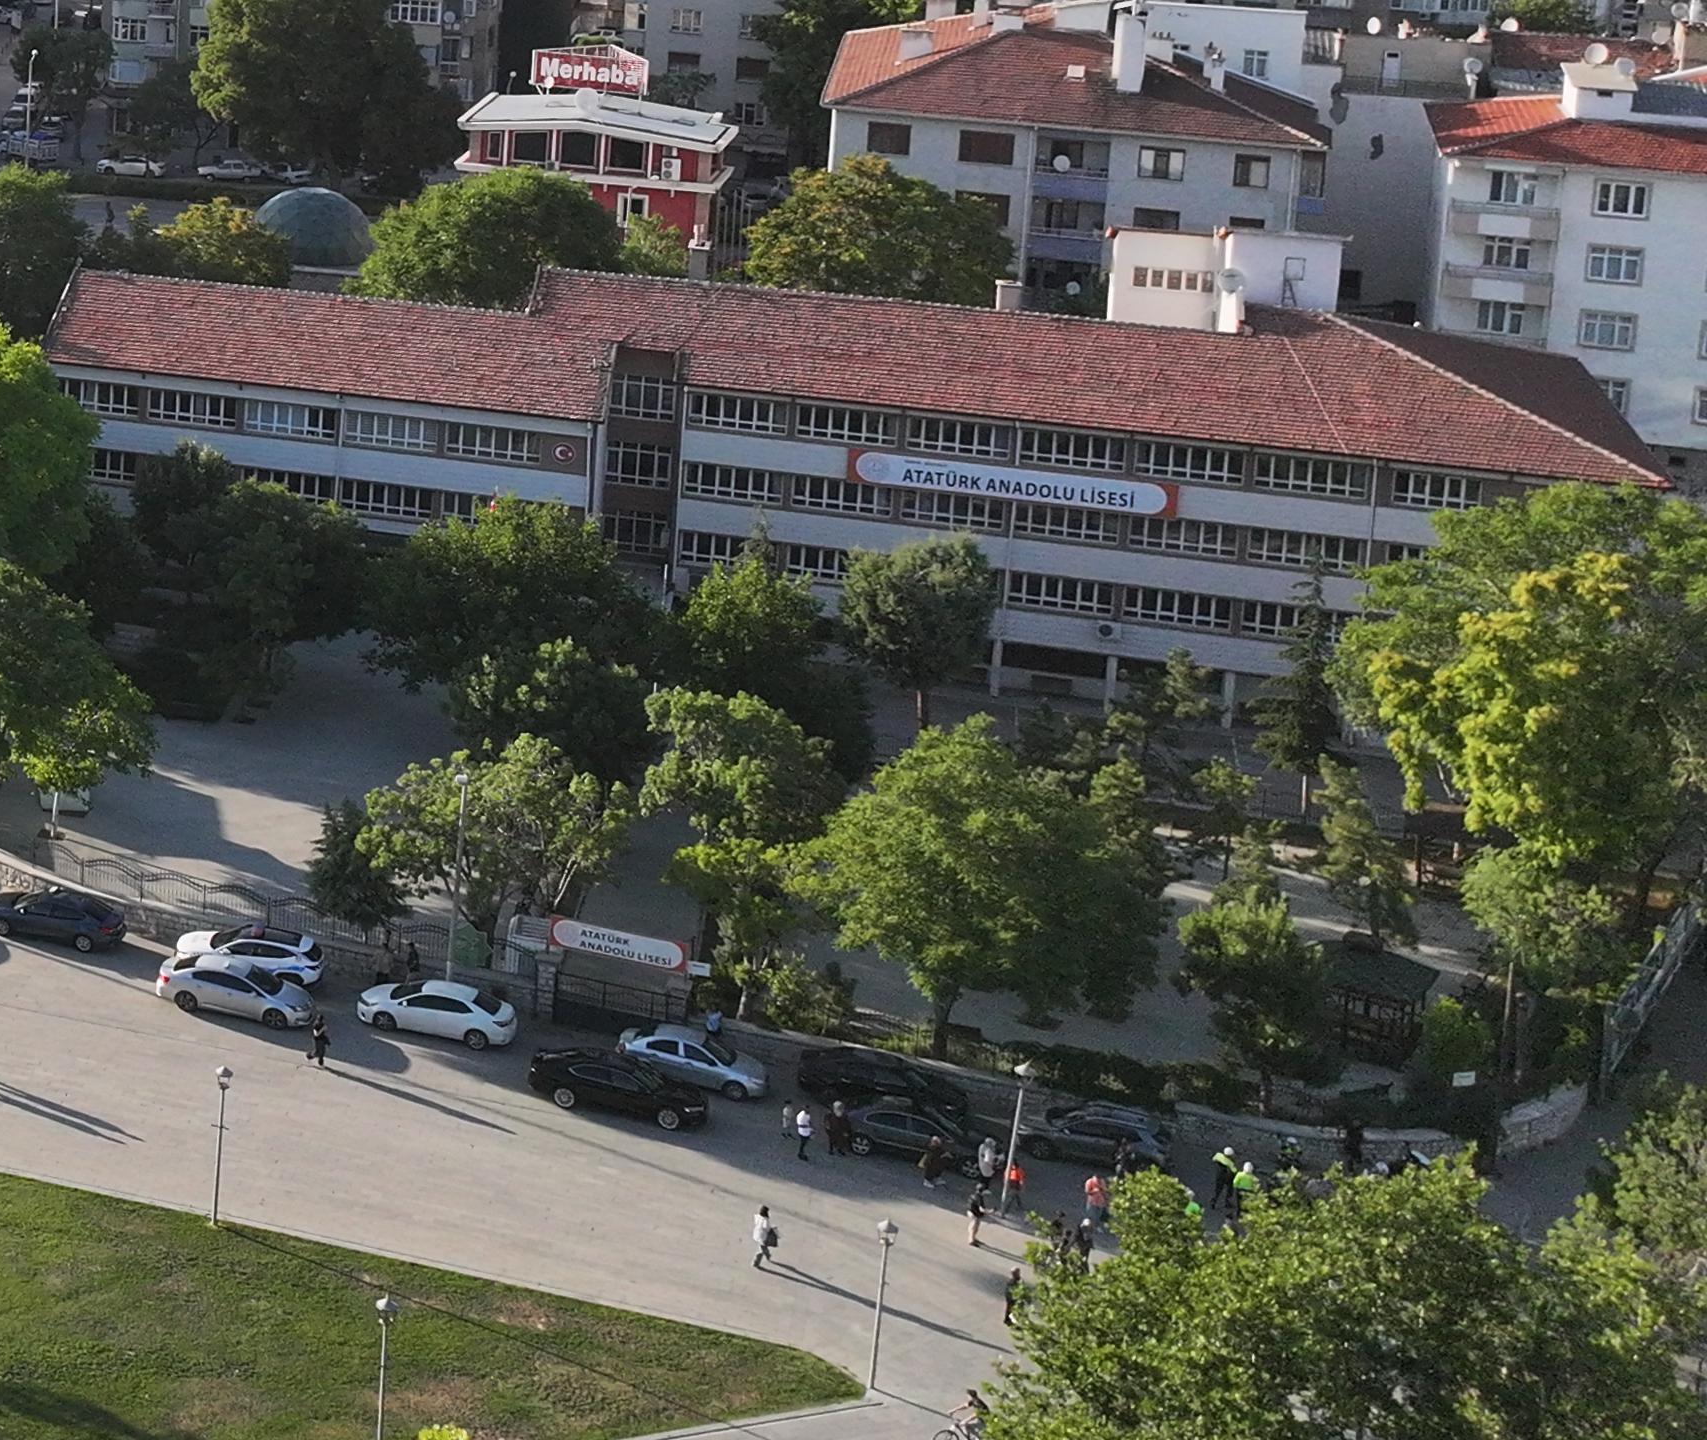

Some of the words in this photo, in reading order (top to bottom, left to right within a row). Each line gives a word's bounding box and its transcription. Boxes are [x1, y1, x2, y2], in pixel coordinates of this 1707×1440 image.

[540, 56, 639, 86] Merhaba
[902, 469, 982, 490] ATATÜRK
[985, 478, 1075, 501] ANADOLU
[1080, 486, 1135, 509] LİSESİ
[579, 941, 635, 958] ANADOLU
[637, 952, 672, 966] LİSESİ
